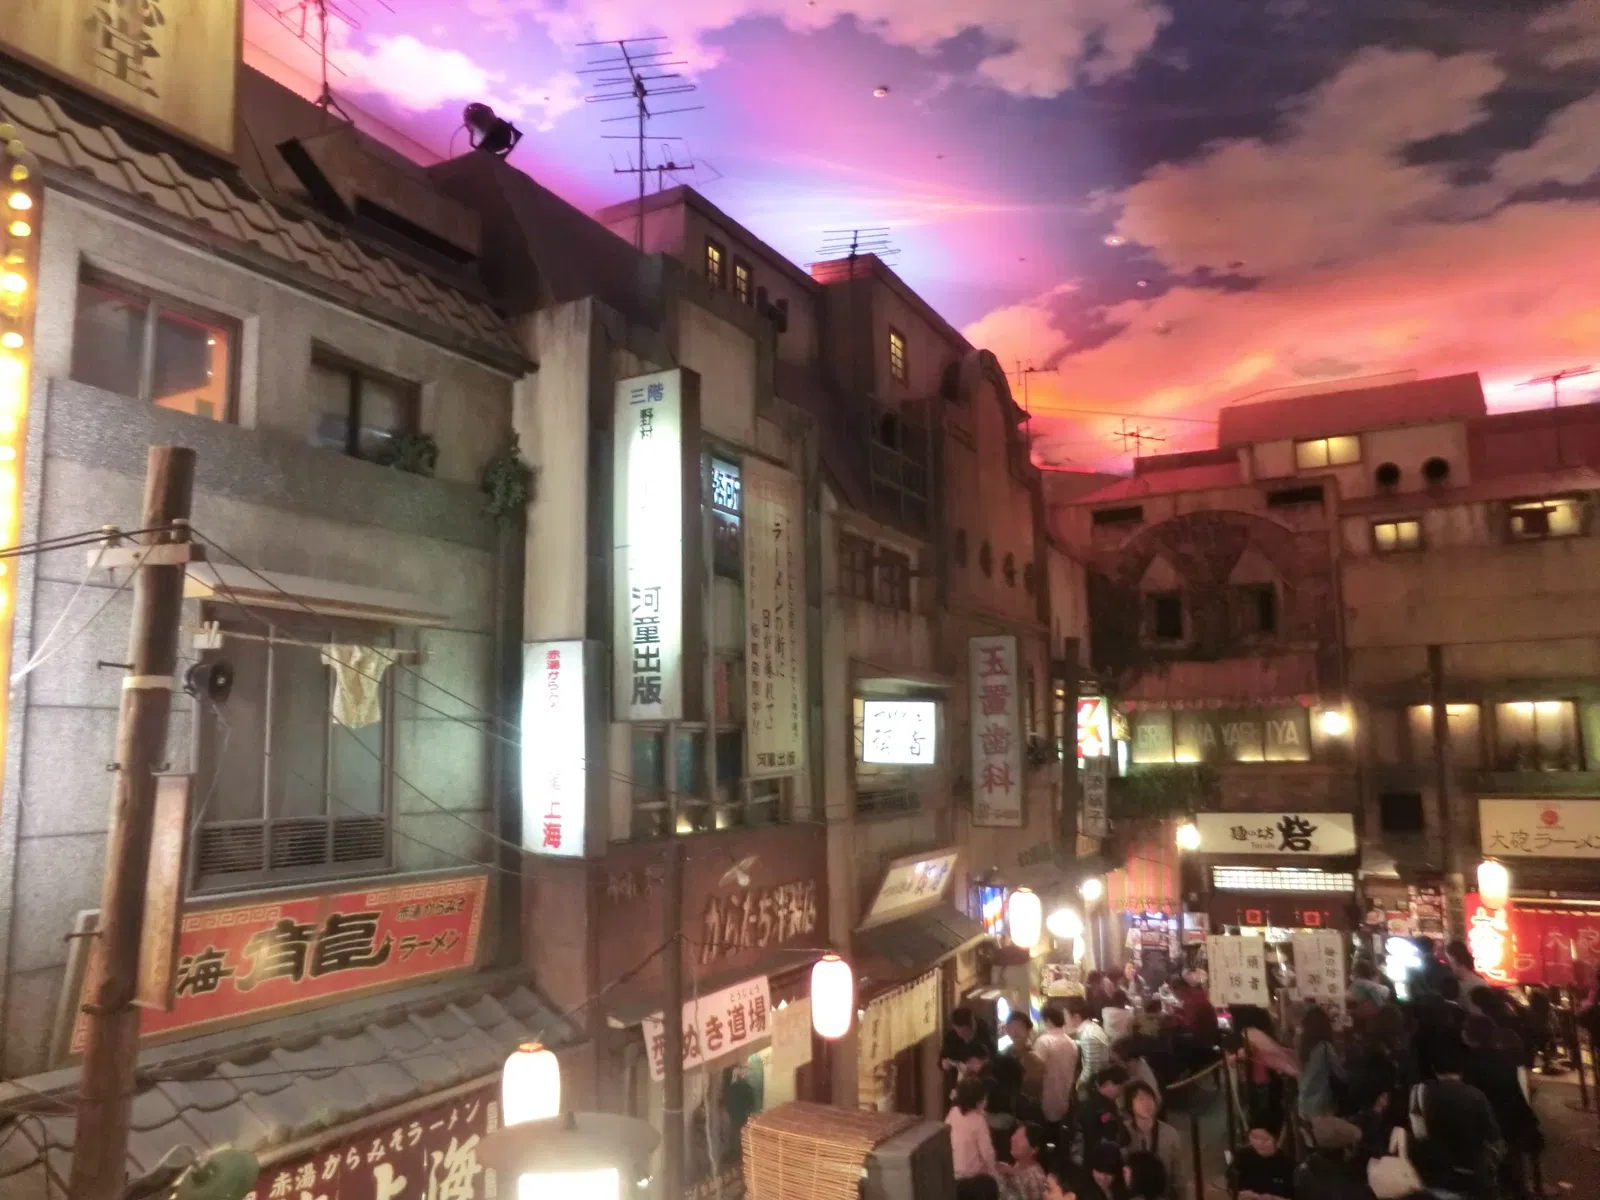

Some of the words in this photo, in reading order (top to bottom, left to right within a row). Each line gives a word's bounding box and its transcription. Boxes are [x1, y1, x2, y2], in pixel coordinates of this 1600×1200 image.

[631, 586, 662, 705] 河童出版
[398, 930, 461, 961] ラーメン
[269, 1099, 482, 1199] 赤湯からみそラーメン
